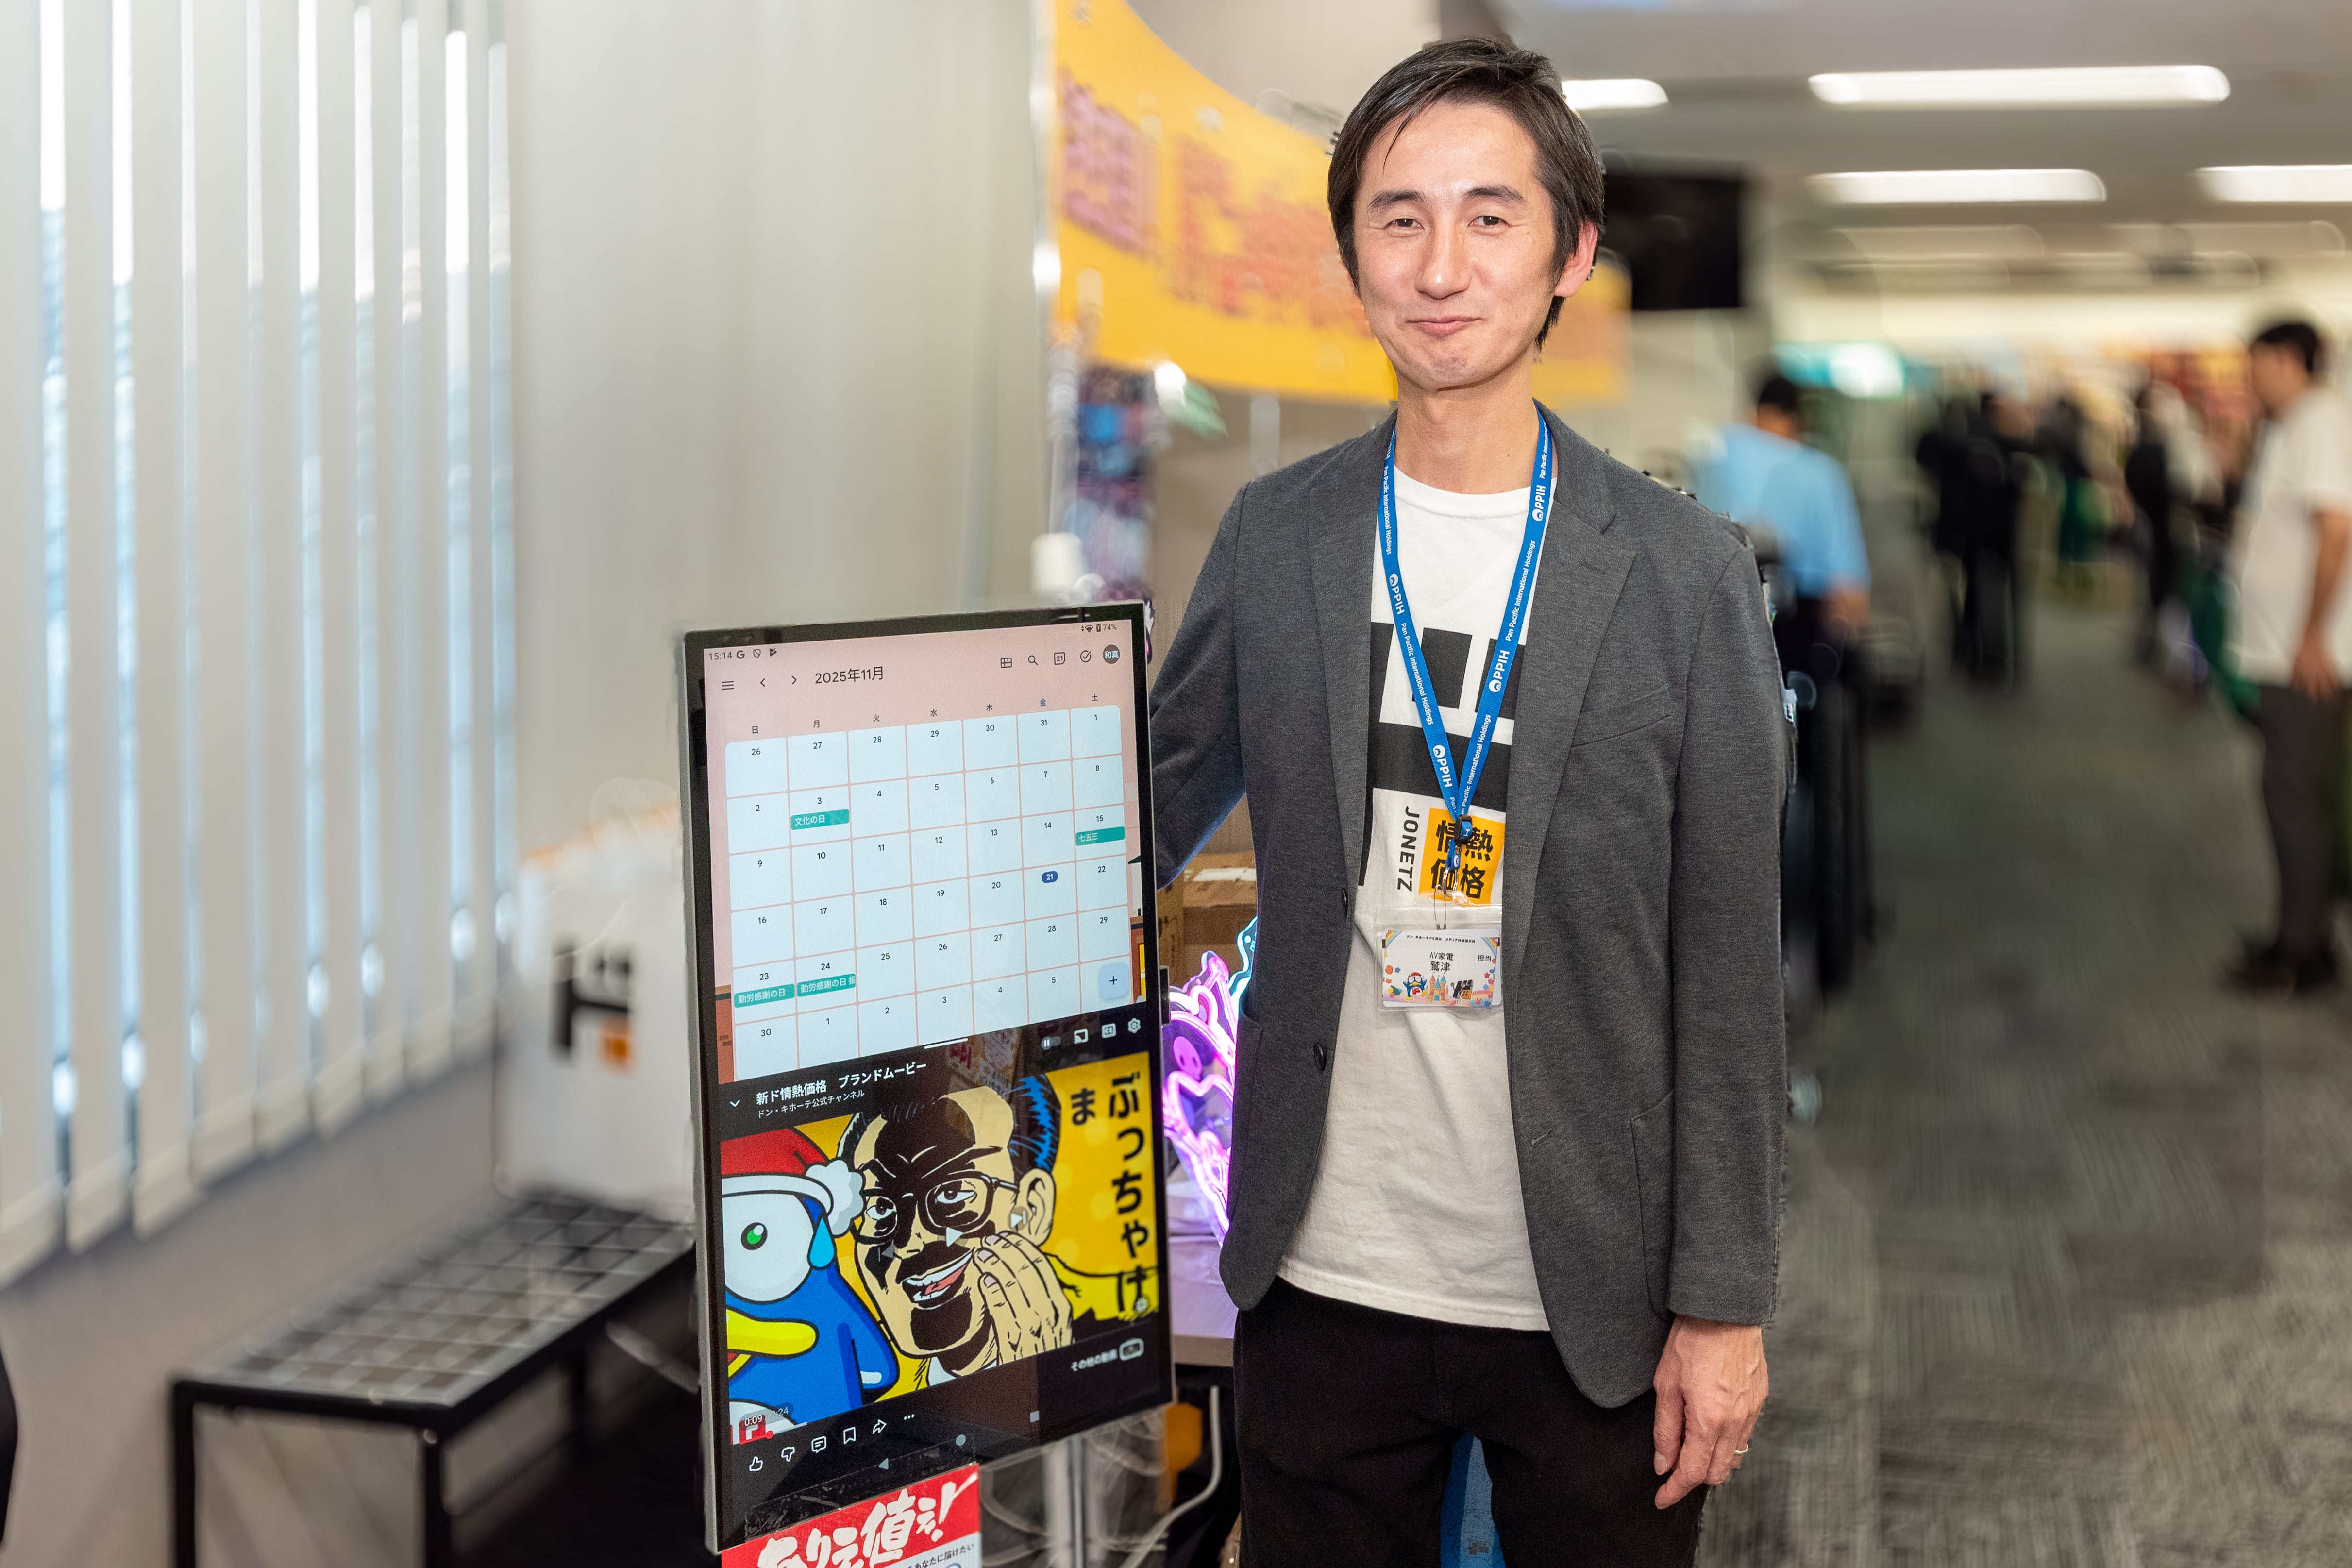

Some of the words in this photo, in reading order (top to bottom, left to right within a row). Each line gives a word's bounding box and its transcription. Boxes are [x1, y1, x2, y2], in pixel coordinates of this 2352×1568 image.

[1534, 485, 1546, 510] PPIH
[1524, 540, 1535, 567] Holdings
[1392, 586, 1405, 615] PPIH
[1514, 568, 1529, 607] International
[1509, 607, 1520, 628] Pacific
[1505, 629, 1514, 641] Pan
[708, 652, 732, 660] 15:14
[1493, 650, 1510, 680] PPIH
[815, 666, 884, 684] 2025年11月
[1404, 635, 1414, 657] Pacific
[1410, 657, 1426, 697] International
[1421, 697, 1433, 725] Holdings
[752, 725, 758, 734] 日
[813, 720, 820, 728] 月
[873, 714, 880, 723] 火
[930, 708, 938, 717] 水
[1040, 698, 1046, 707] 金
[1092, 693, 1098, 702] 土
[1438, 758, 1453, 788] PPIH
[1462, 785, 1471, 808] Pacific
[1467, 744, 1482, 785] International
[1478, 714, 1491, 744] Holdings
[793, 814, 825, 826] 文化の日
[1078, 832, 1098, 843] 七五三
[1397, 806, 1420, 892] JONETZ
[759, 972, 769, 981] 23
[881, 952, 890, 961] 25
[1429, 952, 1454, 961] AV家電
[738, 988, 786, 1004] 勤労感謝の日
[800, 978, 847, 994] 勤労感謝の日
[761, 1028, 772, 1037] 30
[756, 1079, 827, 1105] 新ド情熱価格
[838, 1062, 926, 1088] ブランドムービー
[758, 1090, 865, 1118] ドン・キホーテ公式チャンネル
[1070, 1088, 1096, 1126] ま
[744, 1414, 763, 1426] 0:09
[771, 1406, 789, 1419] 2:24
